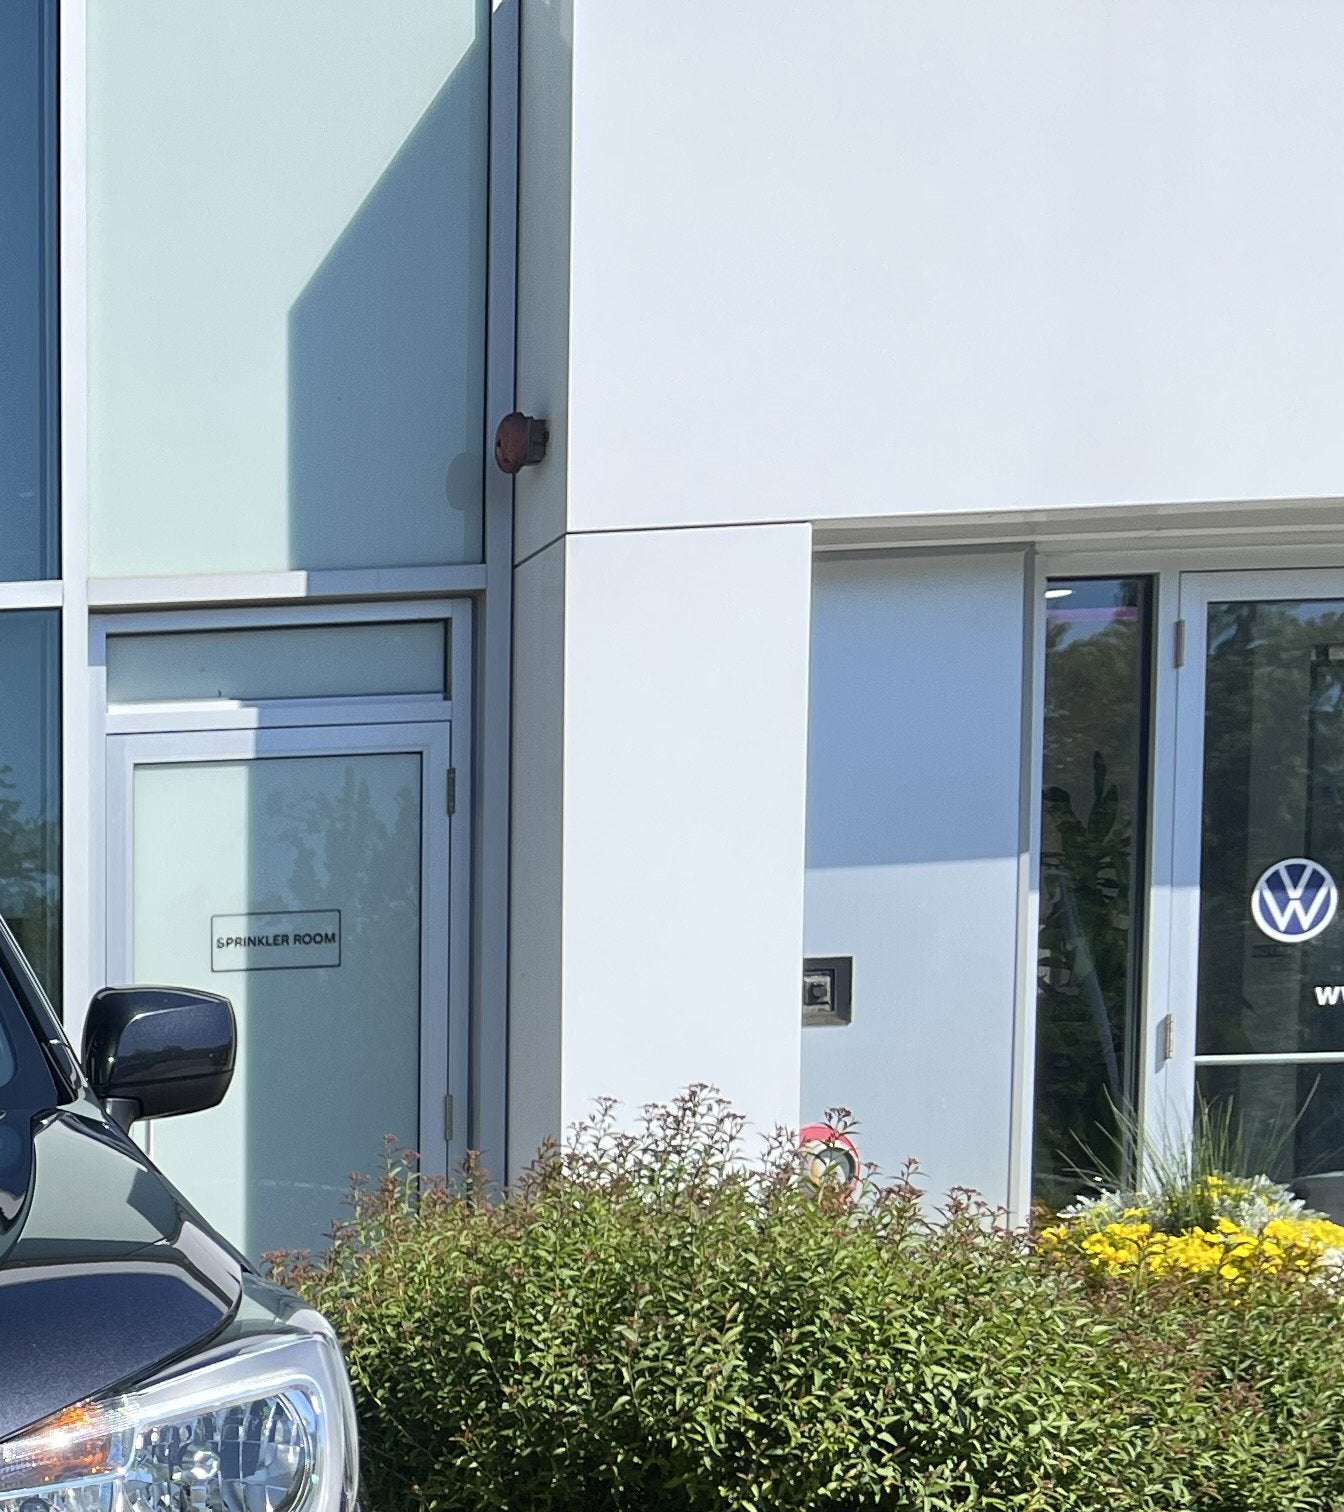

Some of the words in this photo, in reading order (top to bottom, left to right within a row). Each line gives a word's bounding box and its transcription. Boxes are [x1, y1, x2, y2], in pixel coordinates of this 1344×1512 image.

[1252, 858, 1338, 942] VW
[216, 934, 290, 949] SPRINKLER
[293, 932, 336, 945] ROOM
[1314, 985, 1344, 1006] w
